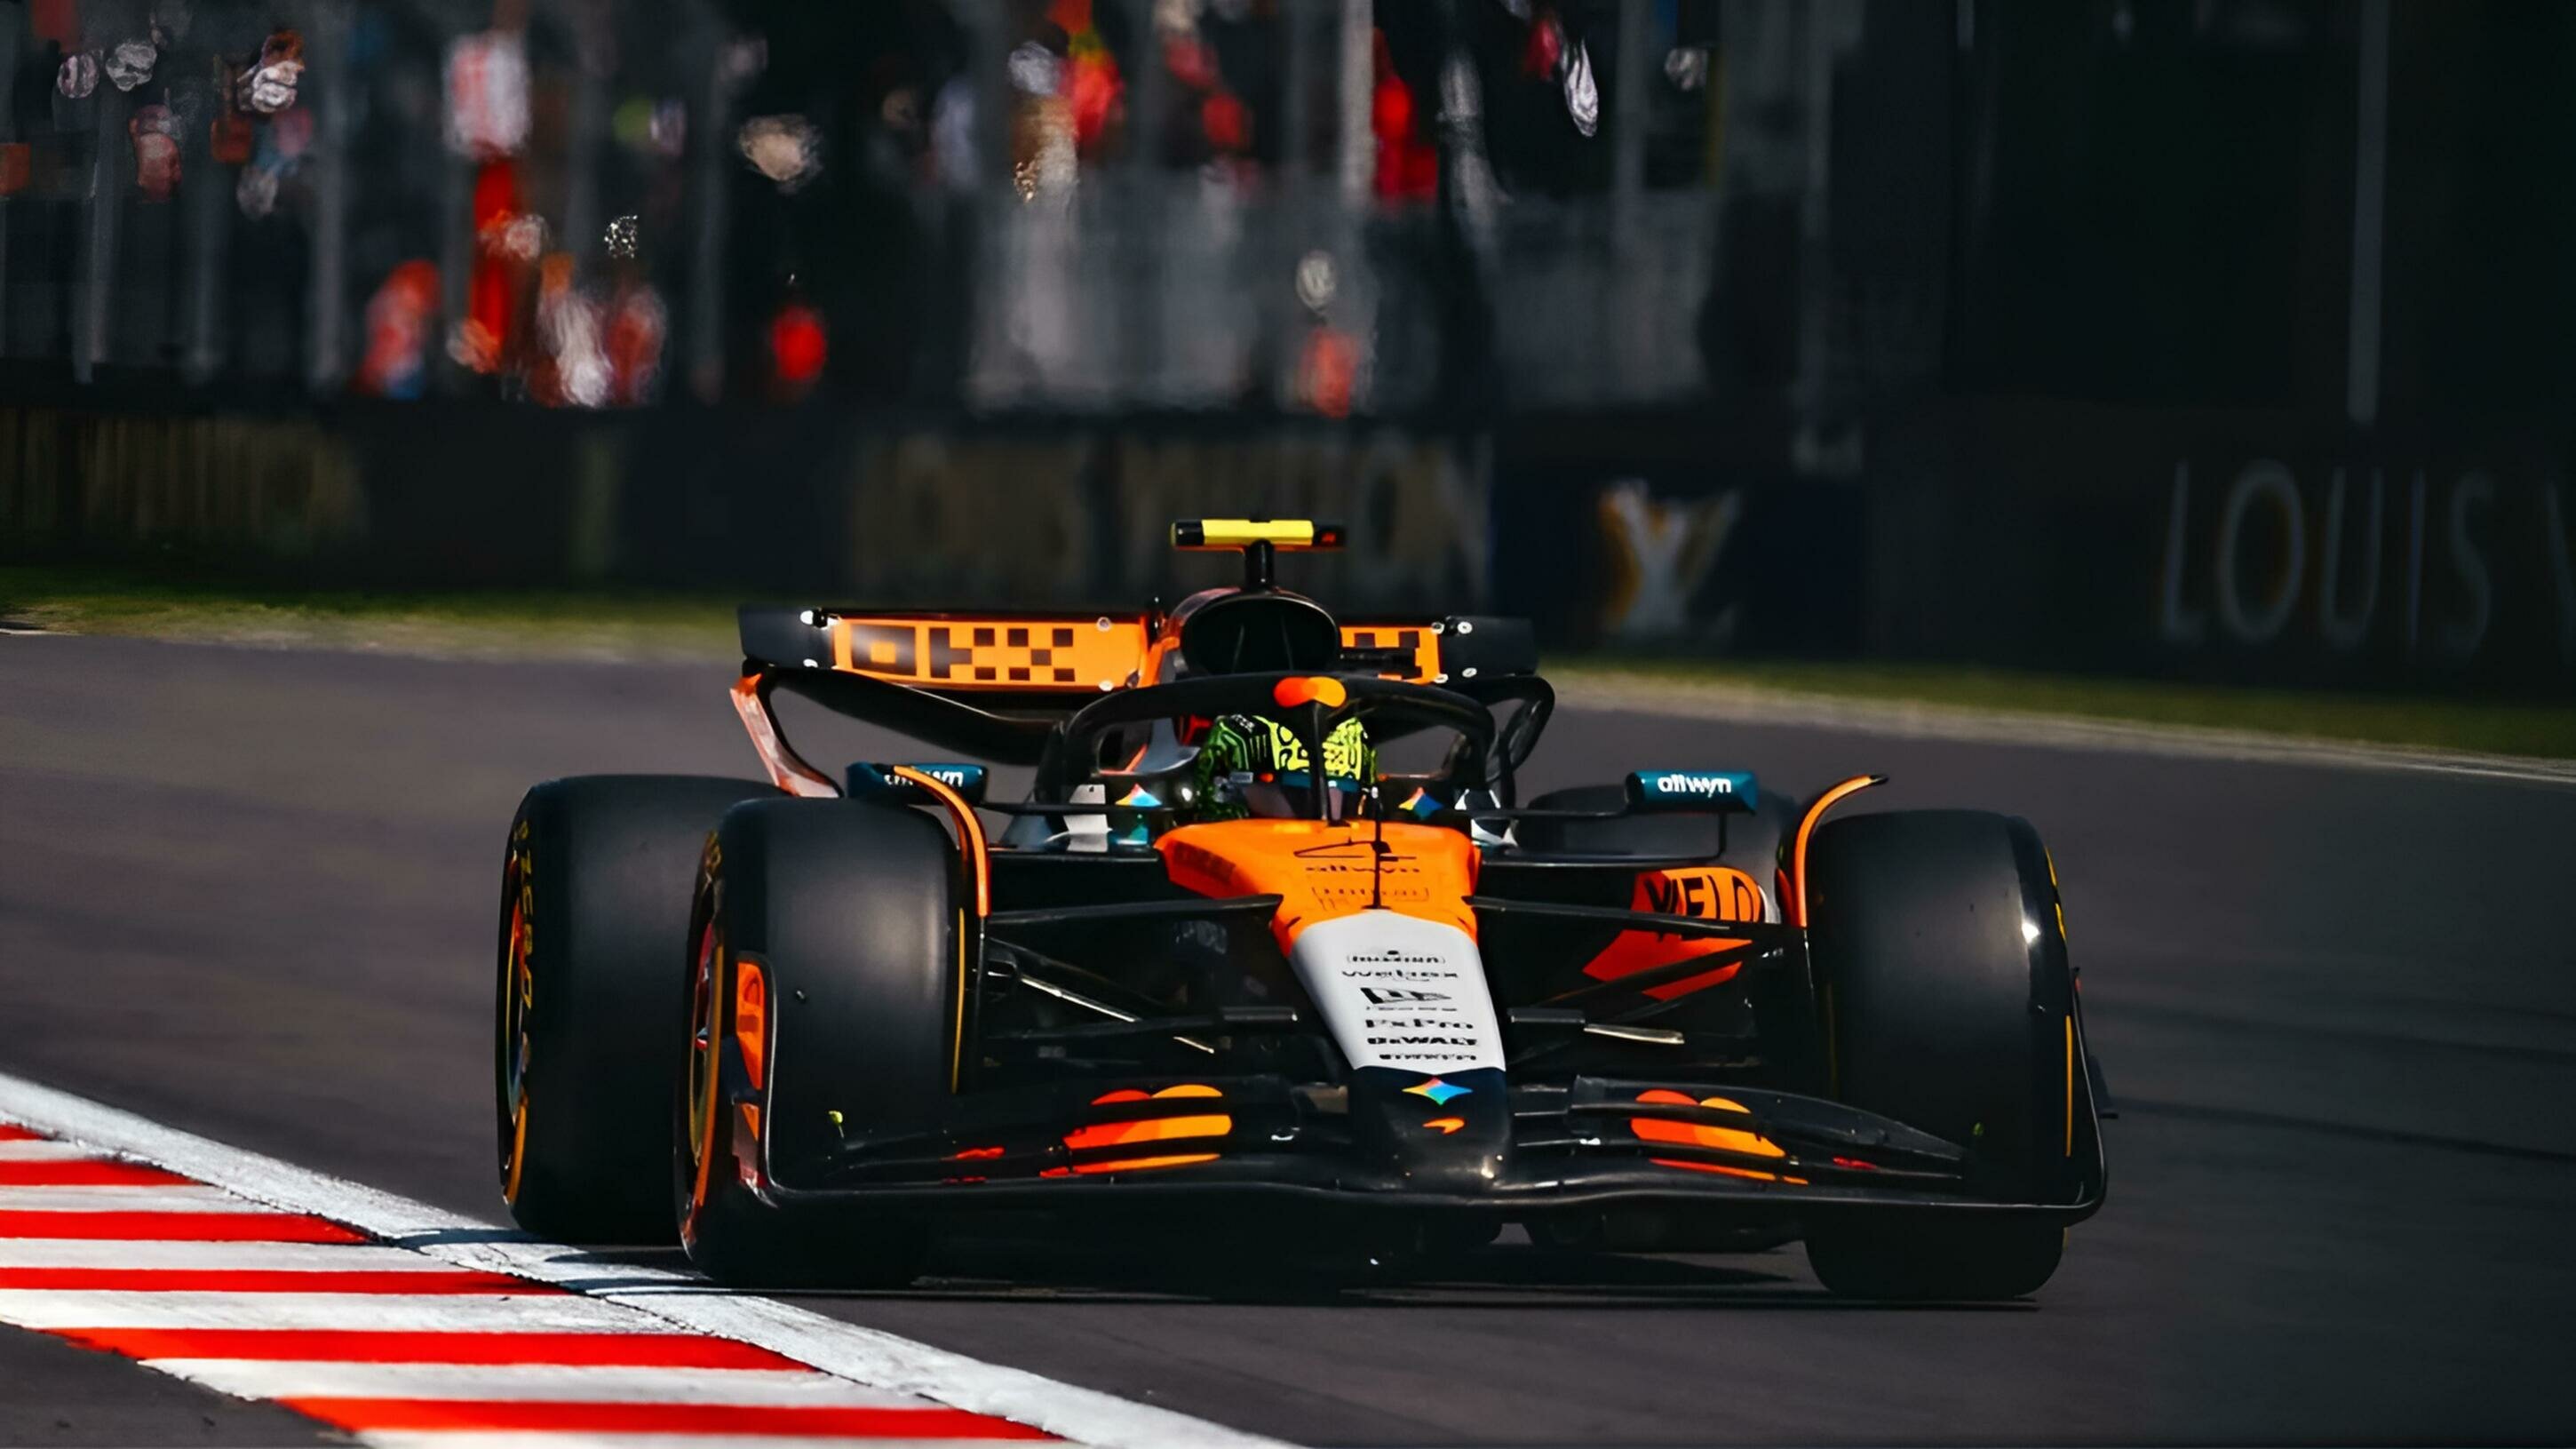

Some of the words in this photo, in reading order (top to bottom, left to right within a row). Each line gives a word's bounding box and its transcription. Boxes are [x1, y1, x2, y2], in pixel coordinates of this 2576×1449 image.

[2161, 457, 2493, 665] LOUIS
[850, 623, 1076, 682] OKX
[1658, 774, 1731, 798] allwyn
